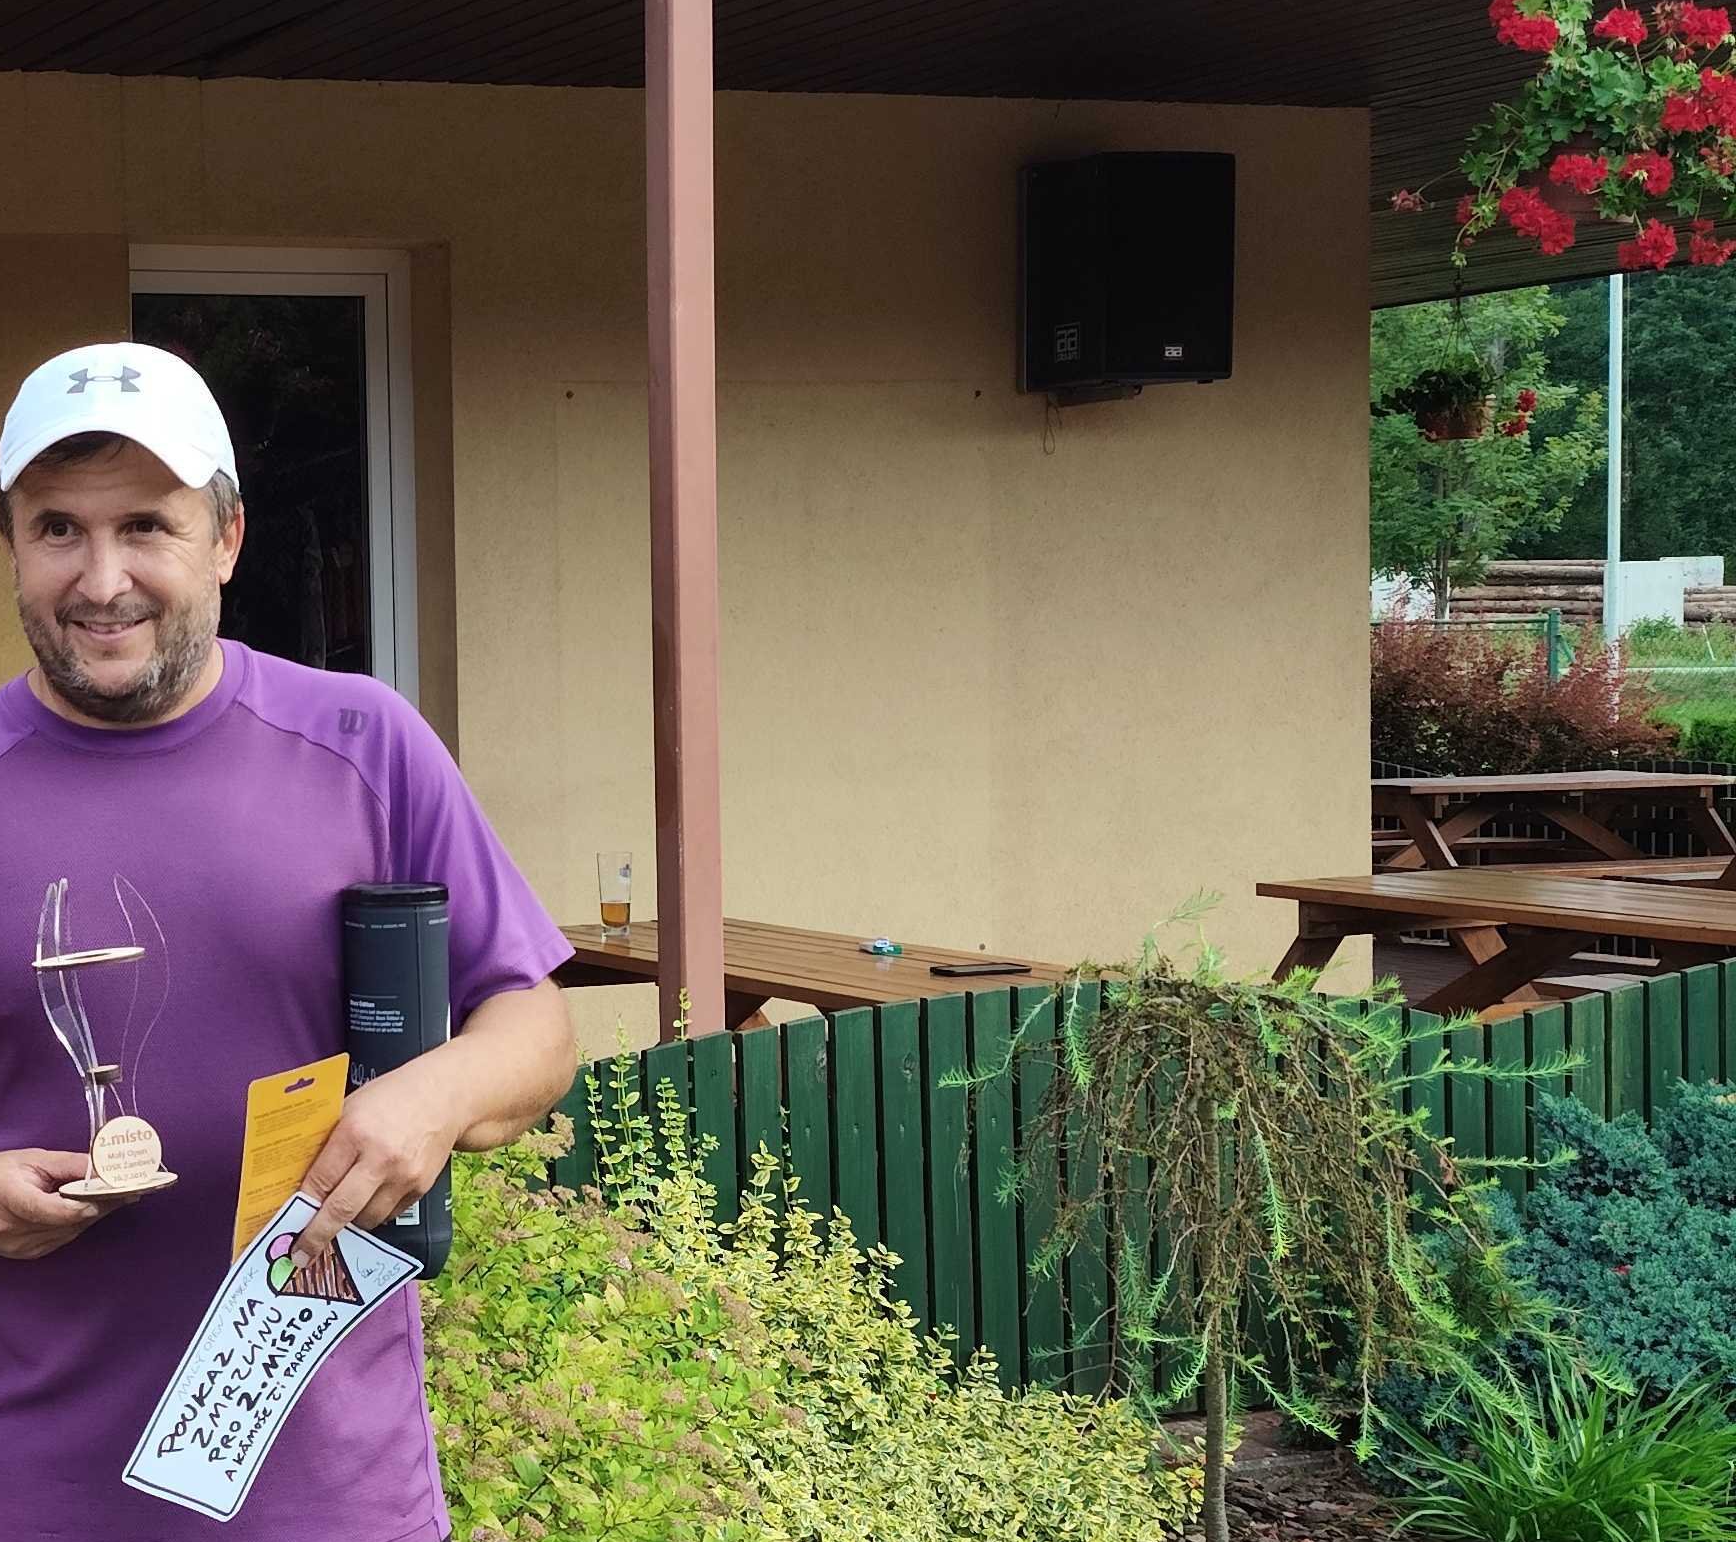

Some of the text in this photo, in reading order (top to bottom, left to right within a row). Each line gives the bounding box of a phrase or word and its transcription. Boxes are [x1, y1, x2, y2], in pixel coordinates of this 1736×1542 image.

[157, 1347, 235, 1458] POUKAZ
[232, 1297, 265, 1339] NA
[208, 1420, 242, 1463] PRO
[224, 1468, 238, 1482] A
